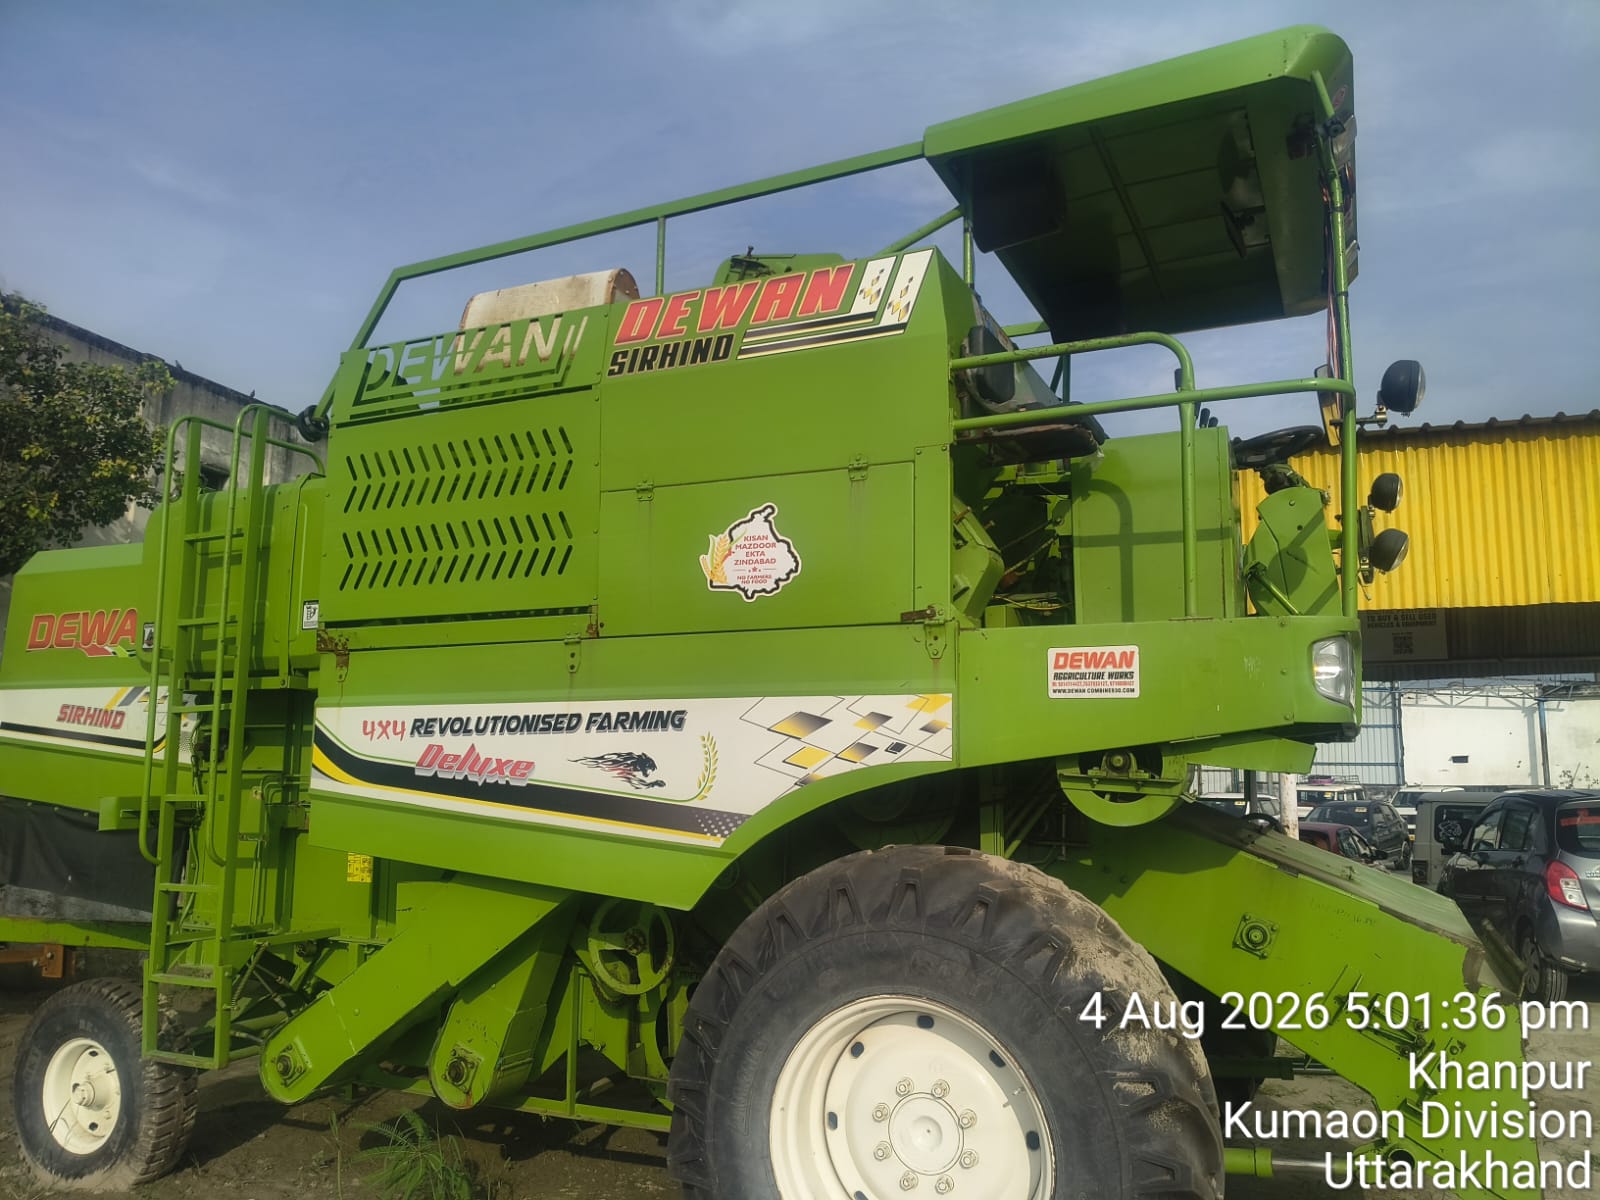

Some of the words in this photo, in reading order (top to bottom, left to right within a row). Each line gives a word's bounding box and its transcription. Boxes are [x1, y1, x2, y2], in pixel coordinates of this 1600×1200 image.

[614, 263, 855, 346] DEWAN
[363, 313, 564, 392] DEWAN
[607, 333, 735, 377] SIRHIND
[735, 542, 777, 550] MAZDOOR
[745, 550, 766, 558] EKTA
[734, 558, 777, 566] ZINDABAD
[26, 608, 138, 652] DEWA
[1053, 651, 1135, 670] DEWAN
[1107, 671, 1134, 680] WORKS
[56, 703, 126, 729] SIRHIND
[409, 712, 582, 738] REVOLUTIONISED
[584, 710, 688, 733] FARMING
[415, 743, 535, 787] Deluxe
